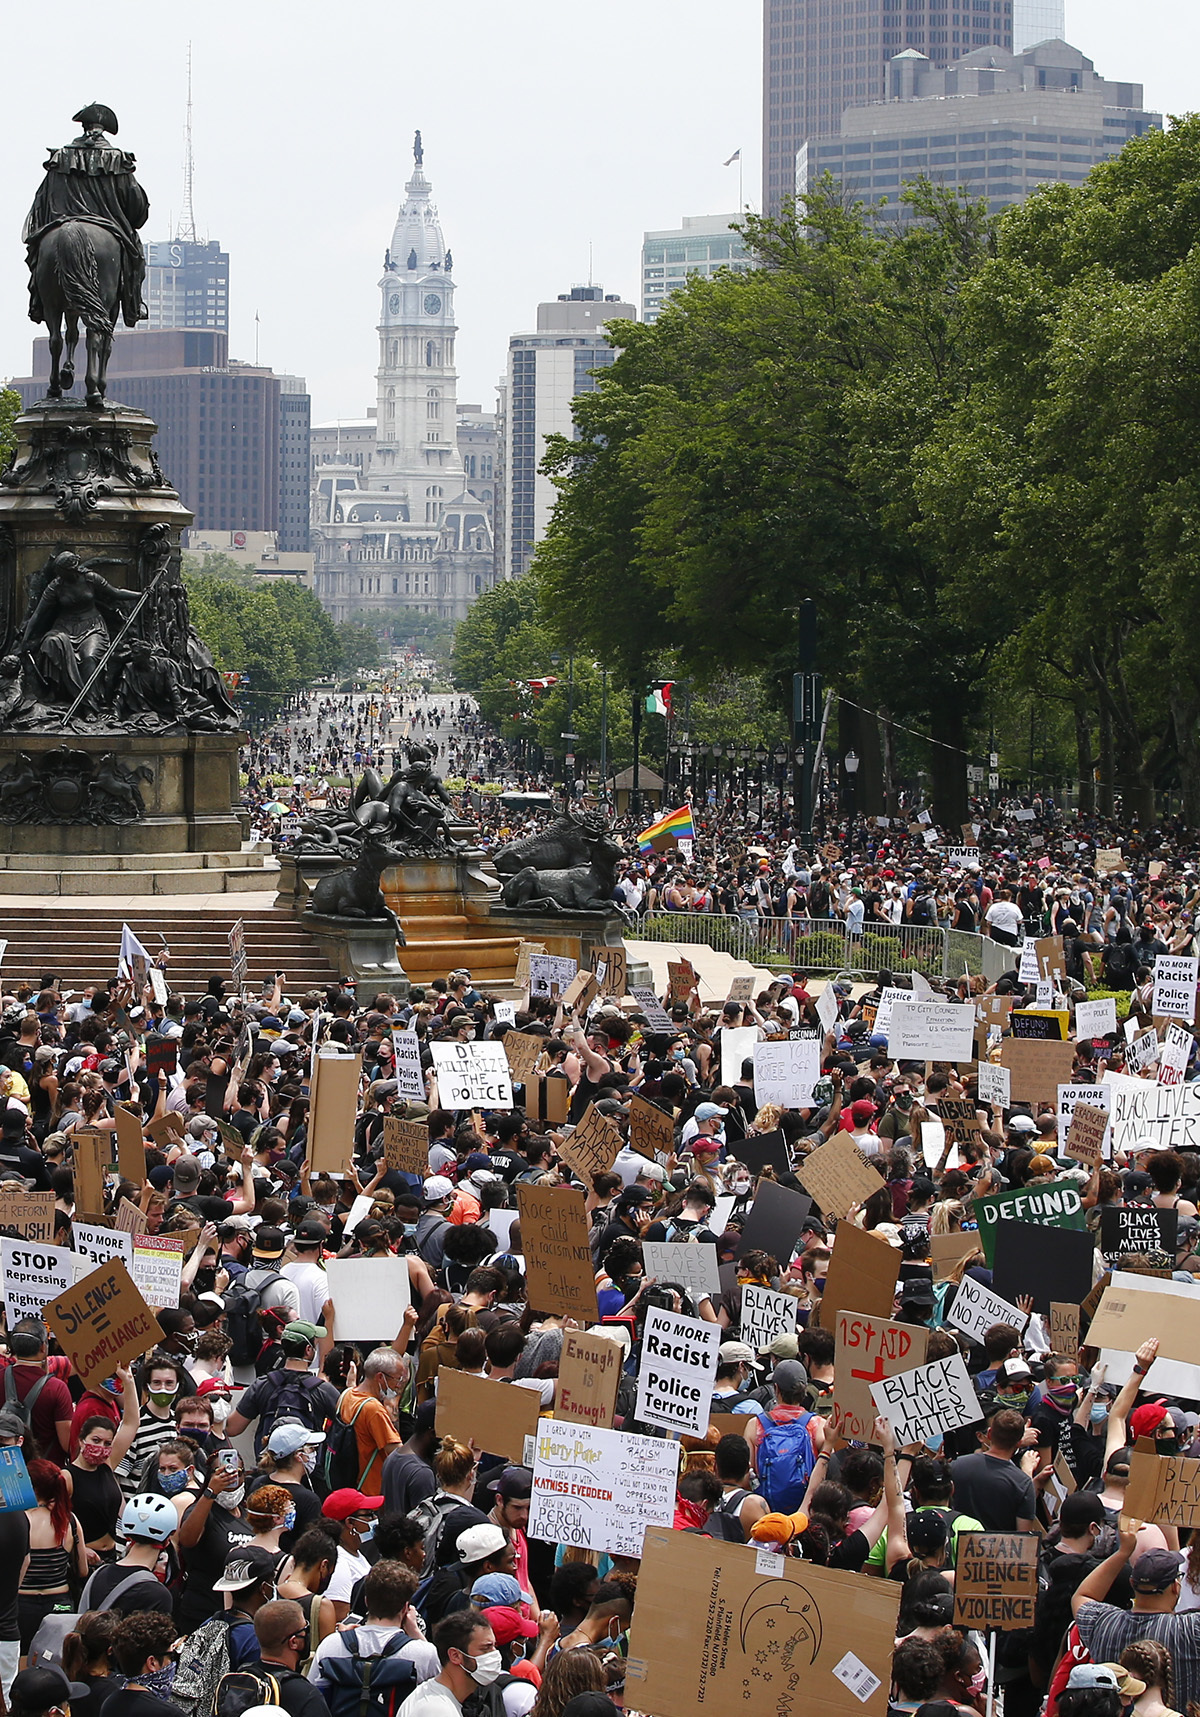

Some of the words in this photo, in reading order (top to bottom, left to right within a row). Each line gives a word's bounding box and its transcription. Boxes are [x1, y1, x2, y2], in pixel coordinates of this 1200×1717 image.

[679, 840, 691, 848] OFF
[950, 848, 978, 858] POWER
[1159, 960, 1170, 968] NO
[1171, 960, 1193, 969] MORE
[1157, 970, 1194, 982] Racist
[632, 990, 653, 999] Justice
[883, 990, 912, 1002] Justice
[1038, 987, 1050, 996] STOP
[1158, 988, 1190, 1000] Police
[498, 1008, 511, 1018] STOP
[906, 1004, 916, 1013] TO
[918, 1006, 932, 1014] CITY
[934, 1006, 962, 1015] COUNCIL:
[1157, 999, 1188, 1010] Terror!
[1014, 1019, 1049, 1030] DEFUND!
[1082, 1022, 1111, 1032] MURDER?
[505, 1034, 539, 1054] DISARM
[790, 1030, 817, 1040] BREONNA
[1169, 1024, 1189, 1051] FEAR
[396, 1048, 418, 1060] Racist
[456, 1044, 484, 1059] DE-
[756, 1046, 781, 1062] GET
[789, 1042, 818, 1060] YOUR
[1126, 1044, 1136, 1061] NO
[1142, 1034, 1151, 1051] NO
[400, 1067, 418, 1080] Police
[436, 1058, 508, 1074] MILITARIZE
[1158, 1067, 1184, 1085] VIRUS
[400, 1079, 420, 1091] Terror!
[460, 1073, 488, 1086] THE
[452, 1084, 508, 1101] POLICE
[1062, 1091, 1076, 1099] NO
[1078, 1090, 1104, 1099] MORE
[1157, 1087, 1200, 1118] LIVES
[937, 1098, 976, 1120] ABOLISH
[1074, 1103, 1108, 1128] ERADICATE
[1116, 1092, 1149, 1122] BLACK
[588, 1108, 620, 1151] BLACK
[632, 1108, 672, 1144] SPREAD
[1121, 1119, 1196, 1150] MATTER
[391, 1134, 419, 1149] AGAINST
[582, 1123, 610, 1164] LIVES
[0, 1204, 8, 1217] 4
[10, 1205, 48, 1217] REFORM
[520, 1190, 552, 1221] Race
[557, 1205, 567, 1223] is
[568, 1206, 587, 1225] the
[983, 1188, 1082, 1225] DEFUND
[1118, 1212, 1158, 1228] BLACK
[78, 1231, 92, 1242] NO
[96, 1236, 124, 1250] MORE
[542, 1223, 568, 1241] child
[1128, 1226, 1162, 1240] LIVES
[524, 1237, 535, 1252] of
[539, 1245, 572, 1263] racism,
[573, 1248, 590, 1262] NOT
[650, 1246, 706, 1260] BLACK
[1118, 1238, 1162, 1250] MATTER
[12, 1250, 58, 1271] STOP
[530, 1256, 548, 1270] the
[653, 1260, 706, 1273] LIVES
[6, 1268, 67, 1289] Repressing
[56, 1275, 121, 1334] SILENCE
[745, 1289, 794, 1320] BLACK
[952, 1303, 973, 1324] NO
[962, 1282, 979, 1303] NO
[980, 1298, 1023, 1328] JUSTICE
[651, 1317, 672, 1333] NO
[673, 1324, 711, 1344] MORE
[752, 1309, 787, 1334] LIVES
[1052, 1309, 1078, 1332] BLACK
[72, 1312, 150, 1378] COMPLIANCE
[646, 1334, 711, 1369] Racist
[880, 1328, 912, 1360] AID
[1052, 1336, 1078, 1356] LIVES
[566, 1338, 614, 1373] Enough
[582, 1368, 594, 1387] is
[647, 1372, 701, 1402] Police
[882, 1360, 962, 1404] BLACK
[560, 1388, 606, 1426] Enough
[644, 1392, 698, 1421] Terror!
[900, 1384, 962, 1422] LIVES
[894, 1404, 974, 1447] MATTER
[540, 1438, 571, 1462] Harry
[574, 1440, 602, 1464] Potter
[626, 1446, 661, 1459] RACISM
[620, 1462, 676, 1477] DISCRIMINATION
[534, 1476, 568, 1494] KATNISS
[571, 1484, 612, 1502] EVERDEEN
[626, 1490, 668, 1503] OPPRESSION
[539, 1507, 582, 1526] PERCY
[532, 1519, 592, 1546] JACKSON
[964, 1538, 1024, 1560] ASIAN
[962, 1561, 1030, 1582] SILENCE
[724, 1610, 733, 1623] 125
[956, 1598, 1032, 1622] VIOLENCE
[721, 1624, 732, 1646] Helen
[719, 1647, 729, 1670] Street
